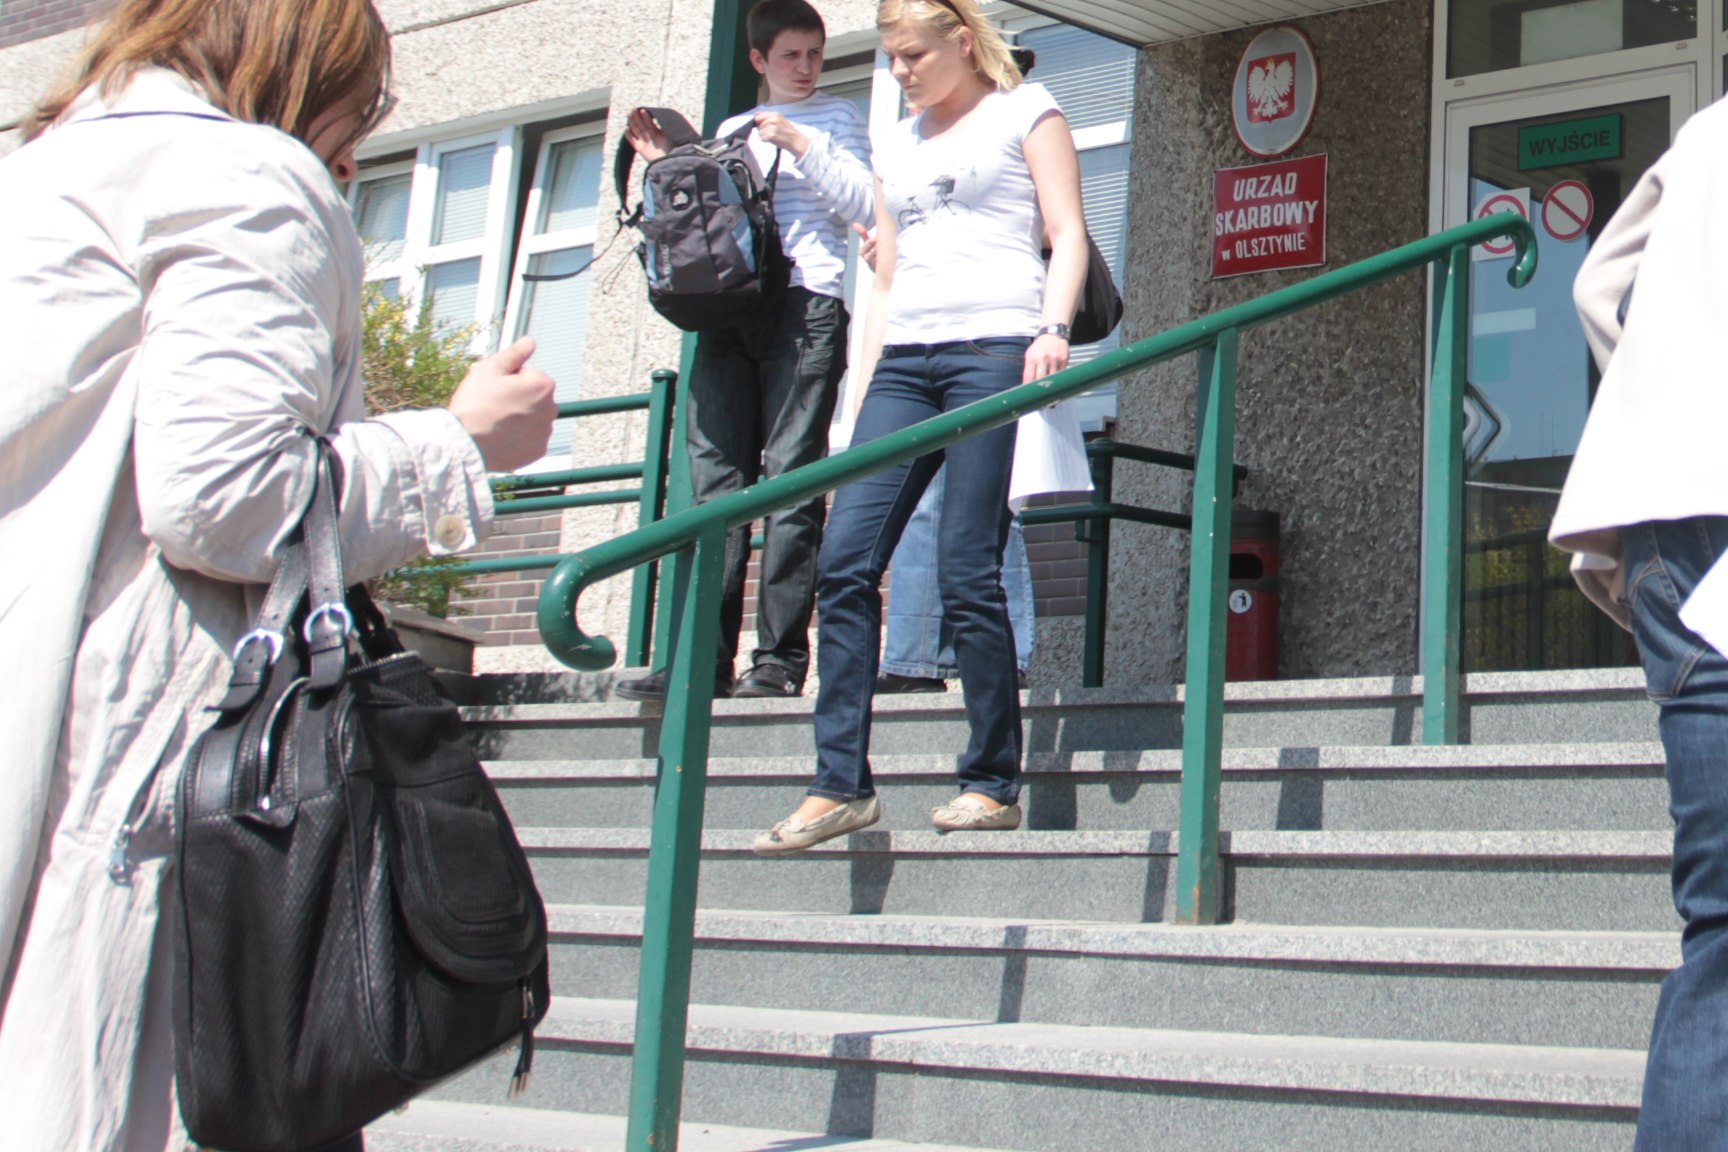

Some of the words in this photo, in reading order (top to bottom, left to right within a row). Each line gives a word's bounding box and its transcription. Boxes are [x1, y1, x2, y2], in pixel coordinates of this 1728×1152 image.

[1528, 130, 1611, 157] WYJŚCIE
[1215, 200, 1319, 237] SKARBOWY
[1221, 250, 1231, 261] w
[1235, 232, 1307, 259] OLSZTYNIE
